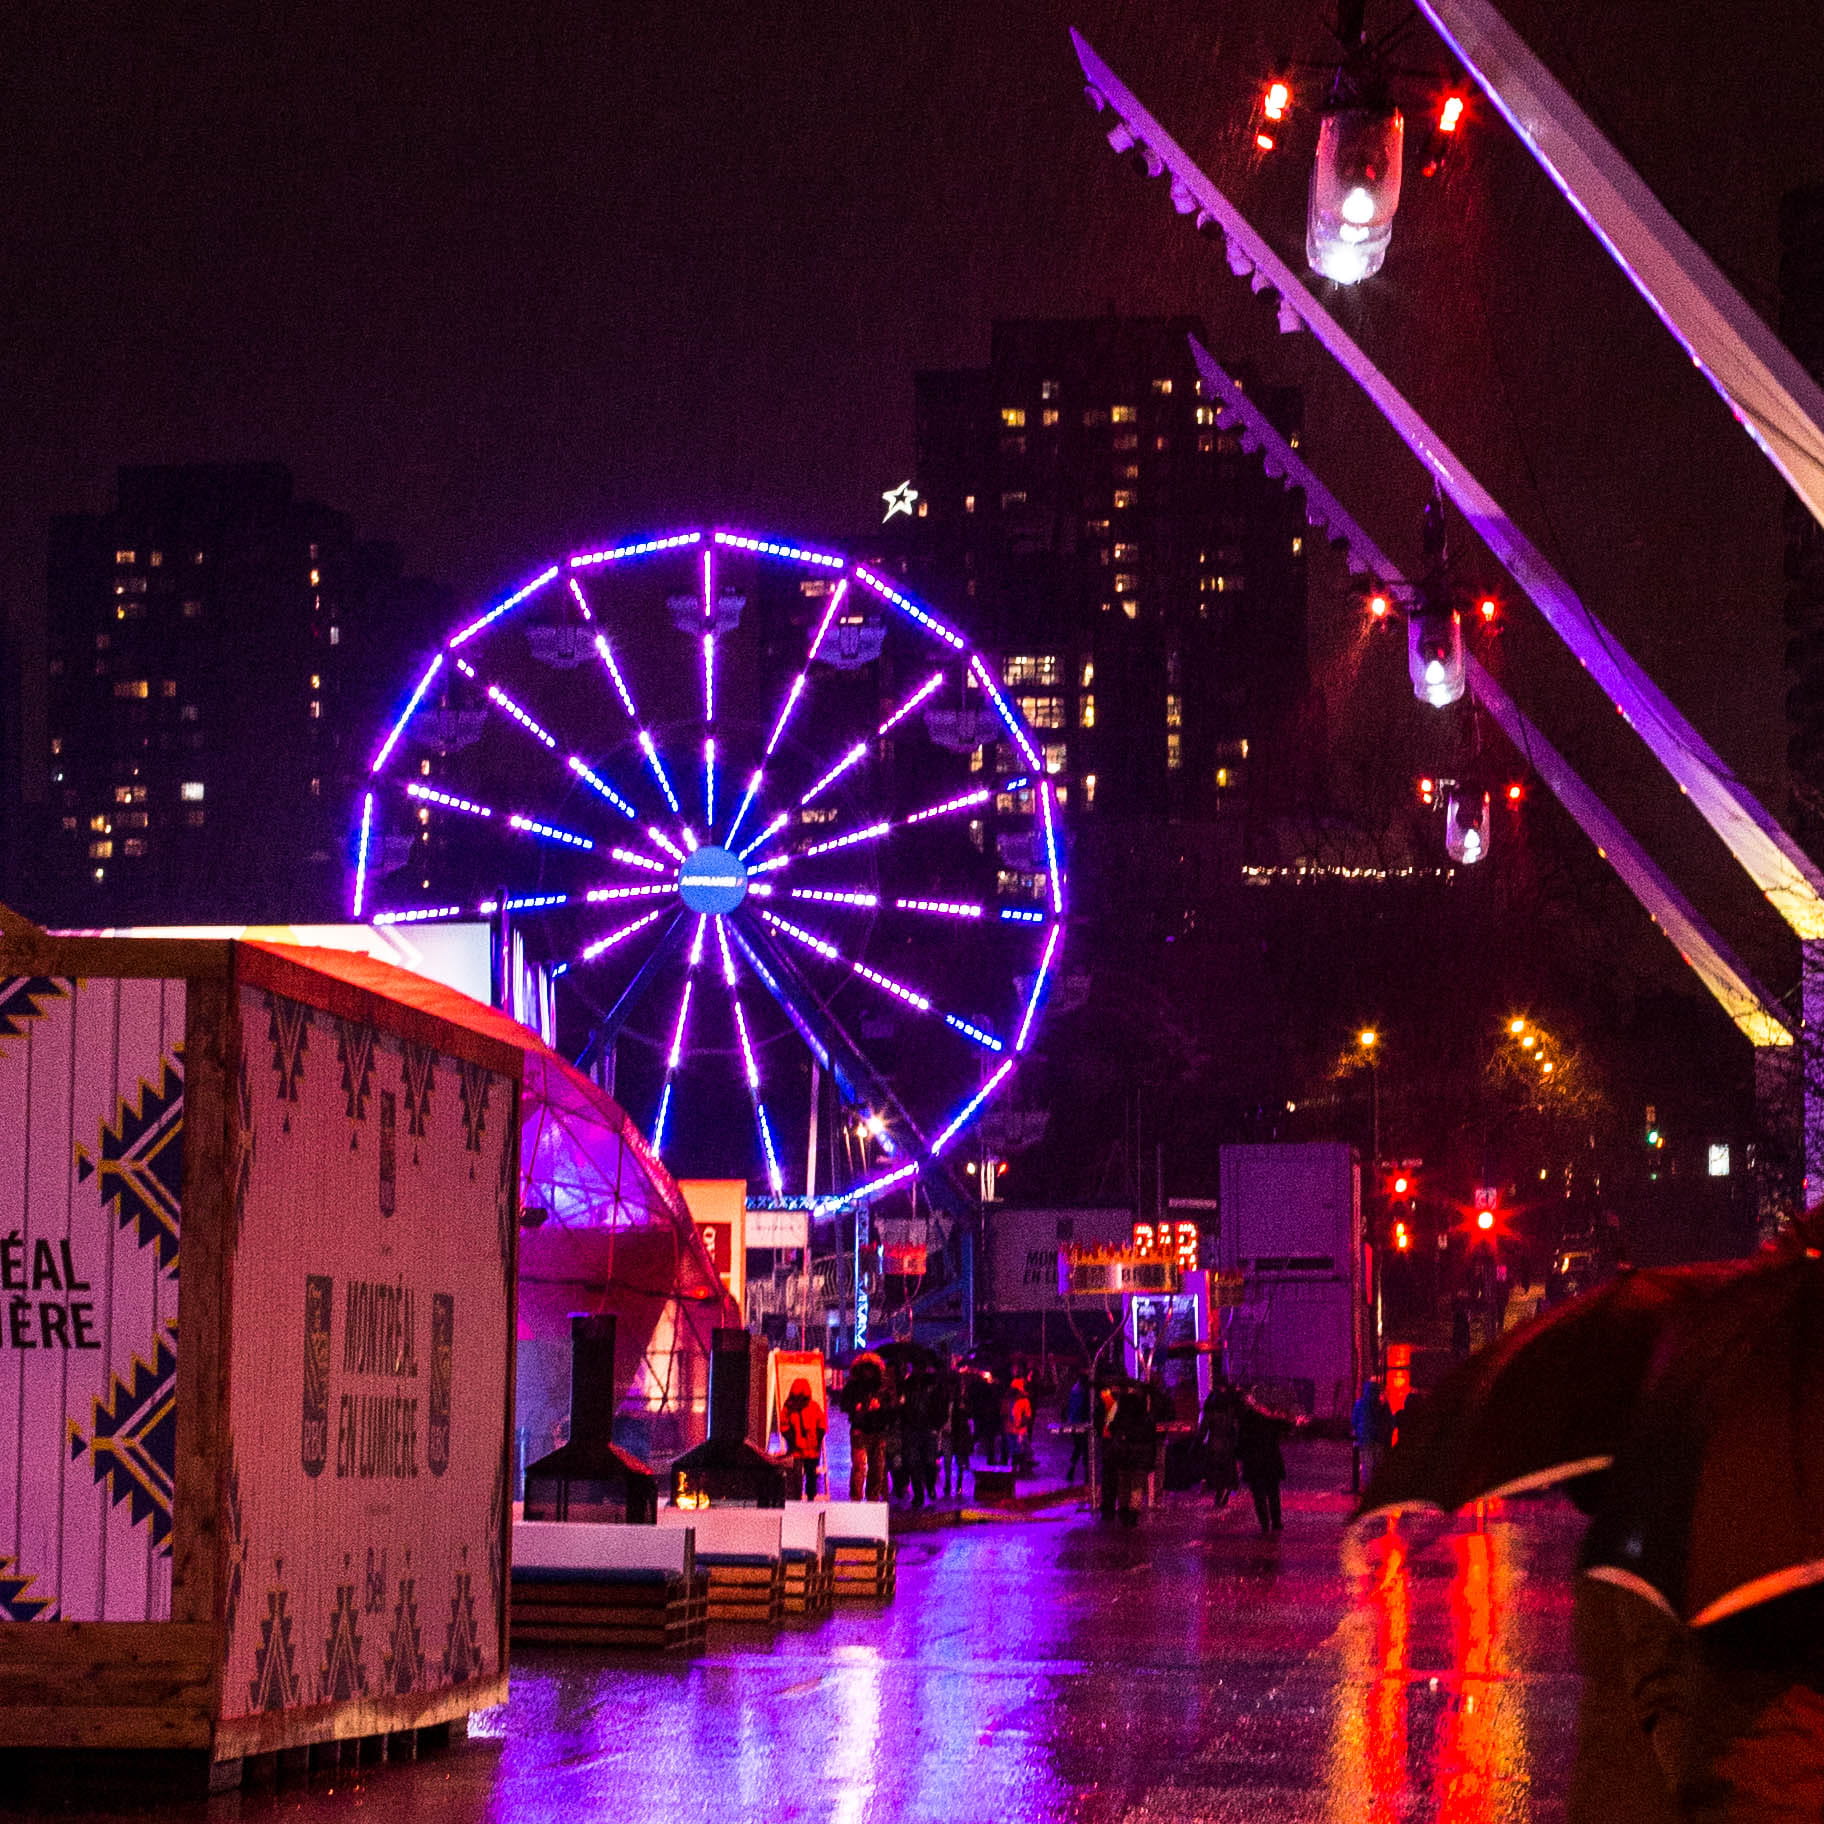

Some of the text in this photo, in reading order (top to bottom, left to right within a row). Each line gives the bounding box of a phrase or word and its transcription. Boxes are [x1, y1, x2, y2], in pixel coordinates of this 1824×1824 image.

[0, 1294, 102, 1350] ÈRE
[343, 1272, 418, 1378] MONTRÉAL
[336, 1383, 418, 1479] EN LUMIÈRE
